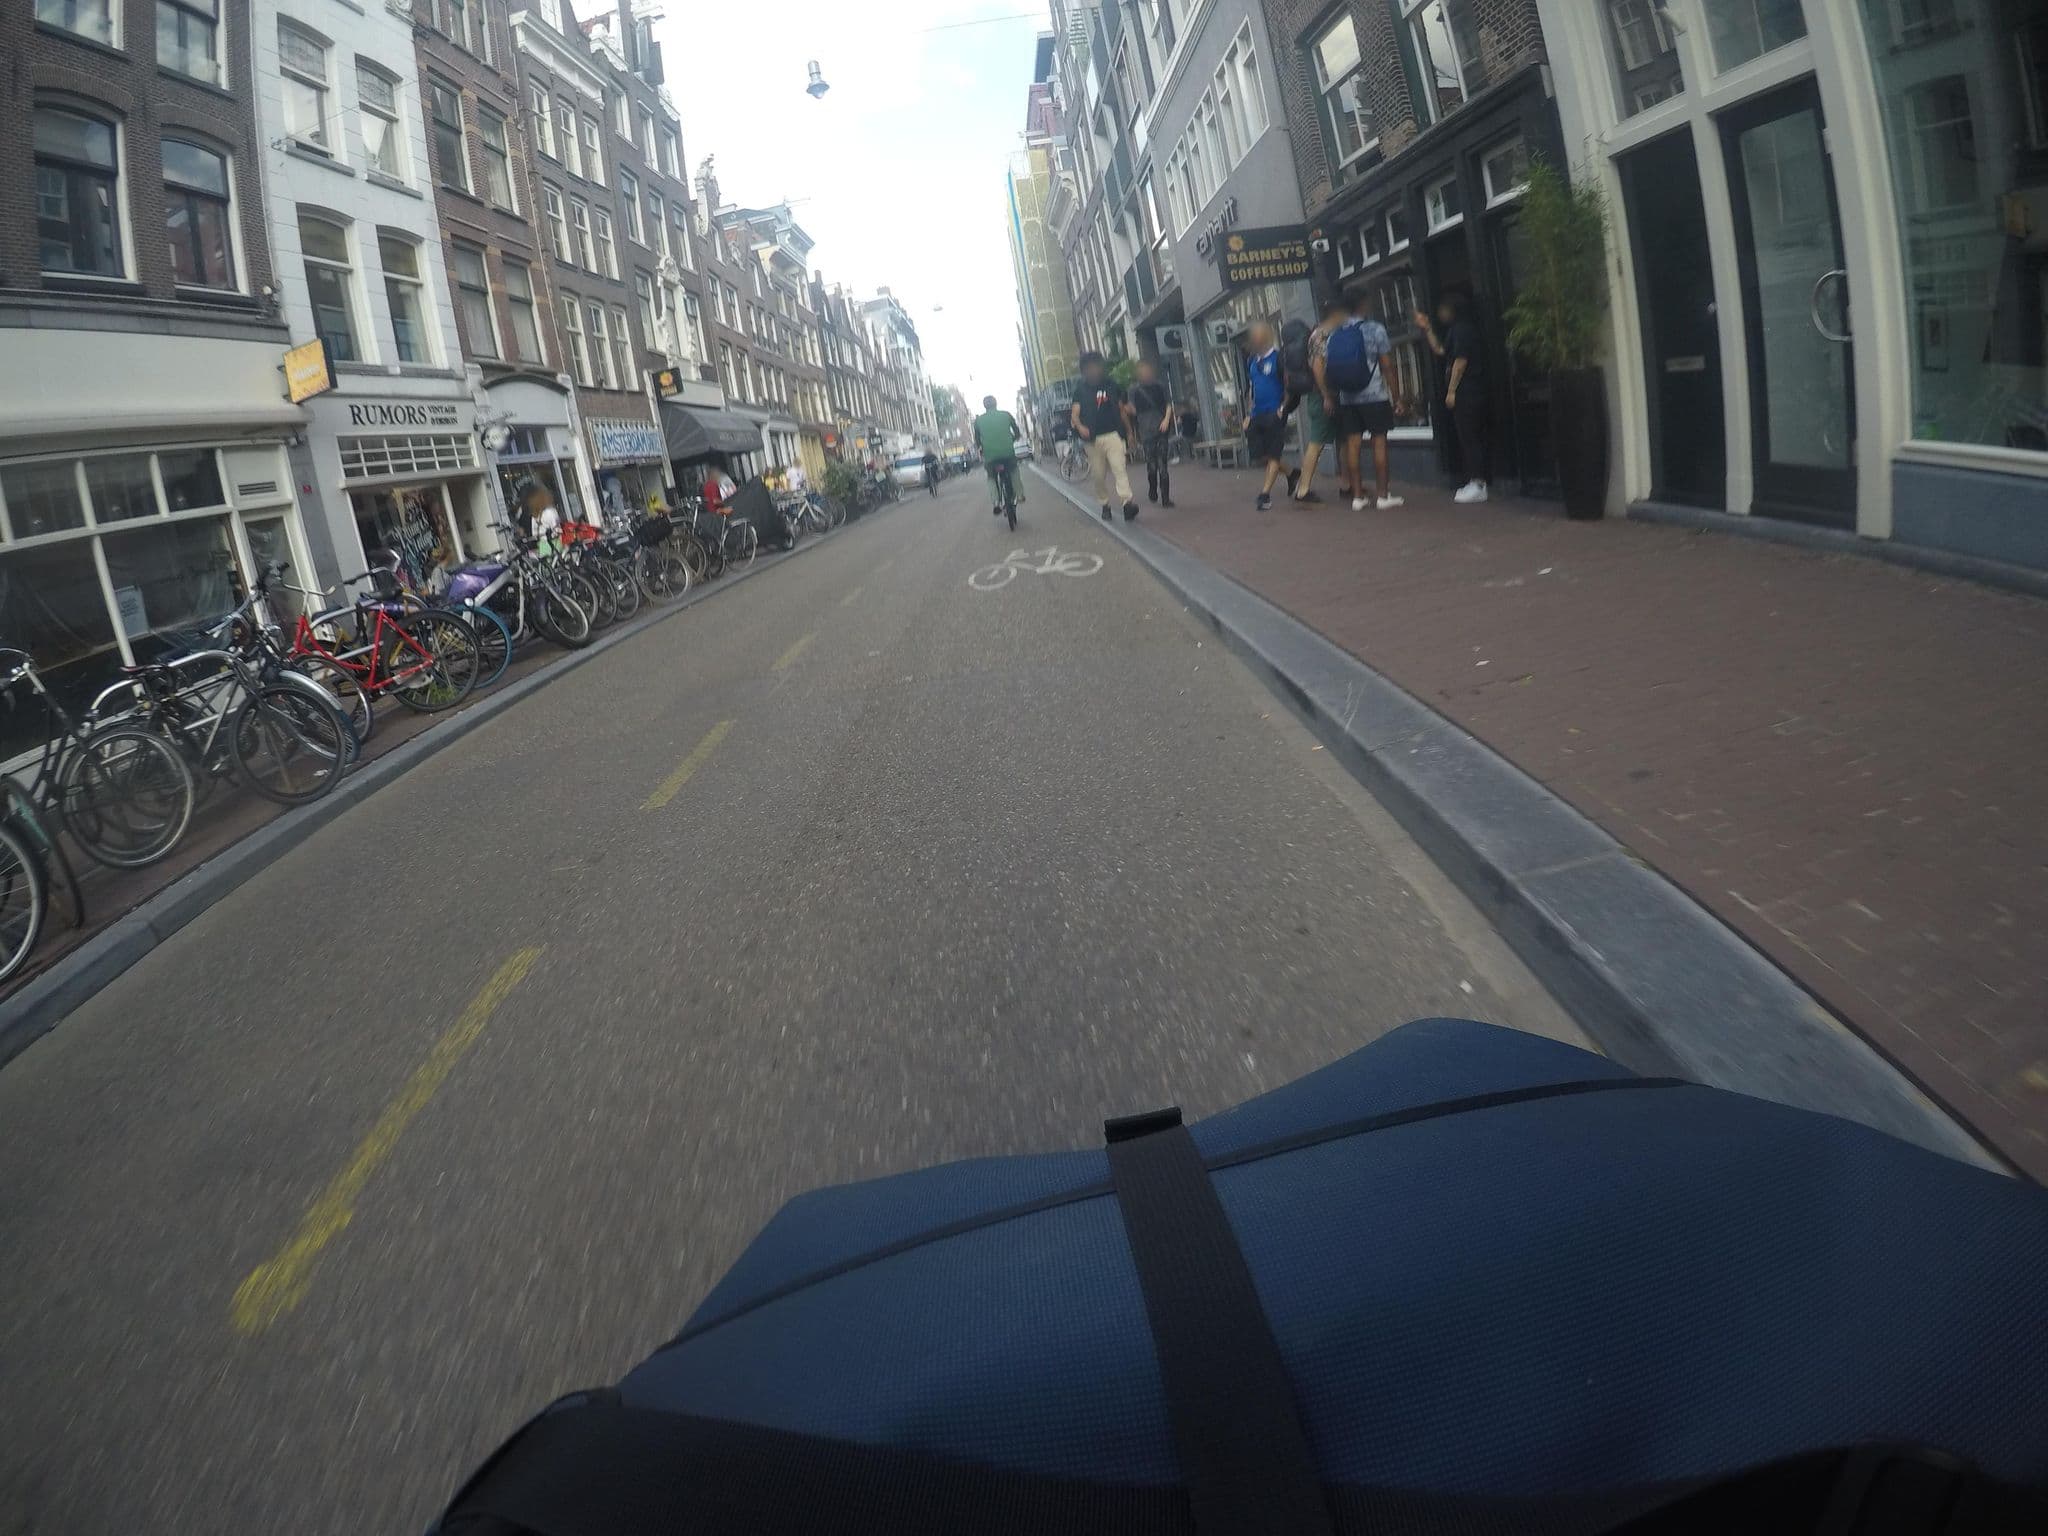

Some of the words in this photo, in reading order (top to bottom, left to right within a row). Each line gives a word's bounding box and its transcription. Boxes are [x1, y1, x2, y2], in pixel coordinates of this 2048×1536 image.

[1227, 245, 1306, 265] BARNEY'S
[1230, 263, 1309, 282] COFFEESHOP
[349, 404, 428, 425] RUMORS
